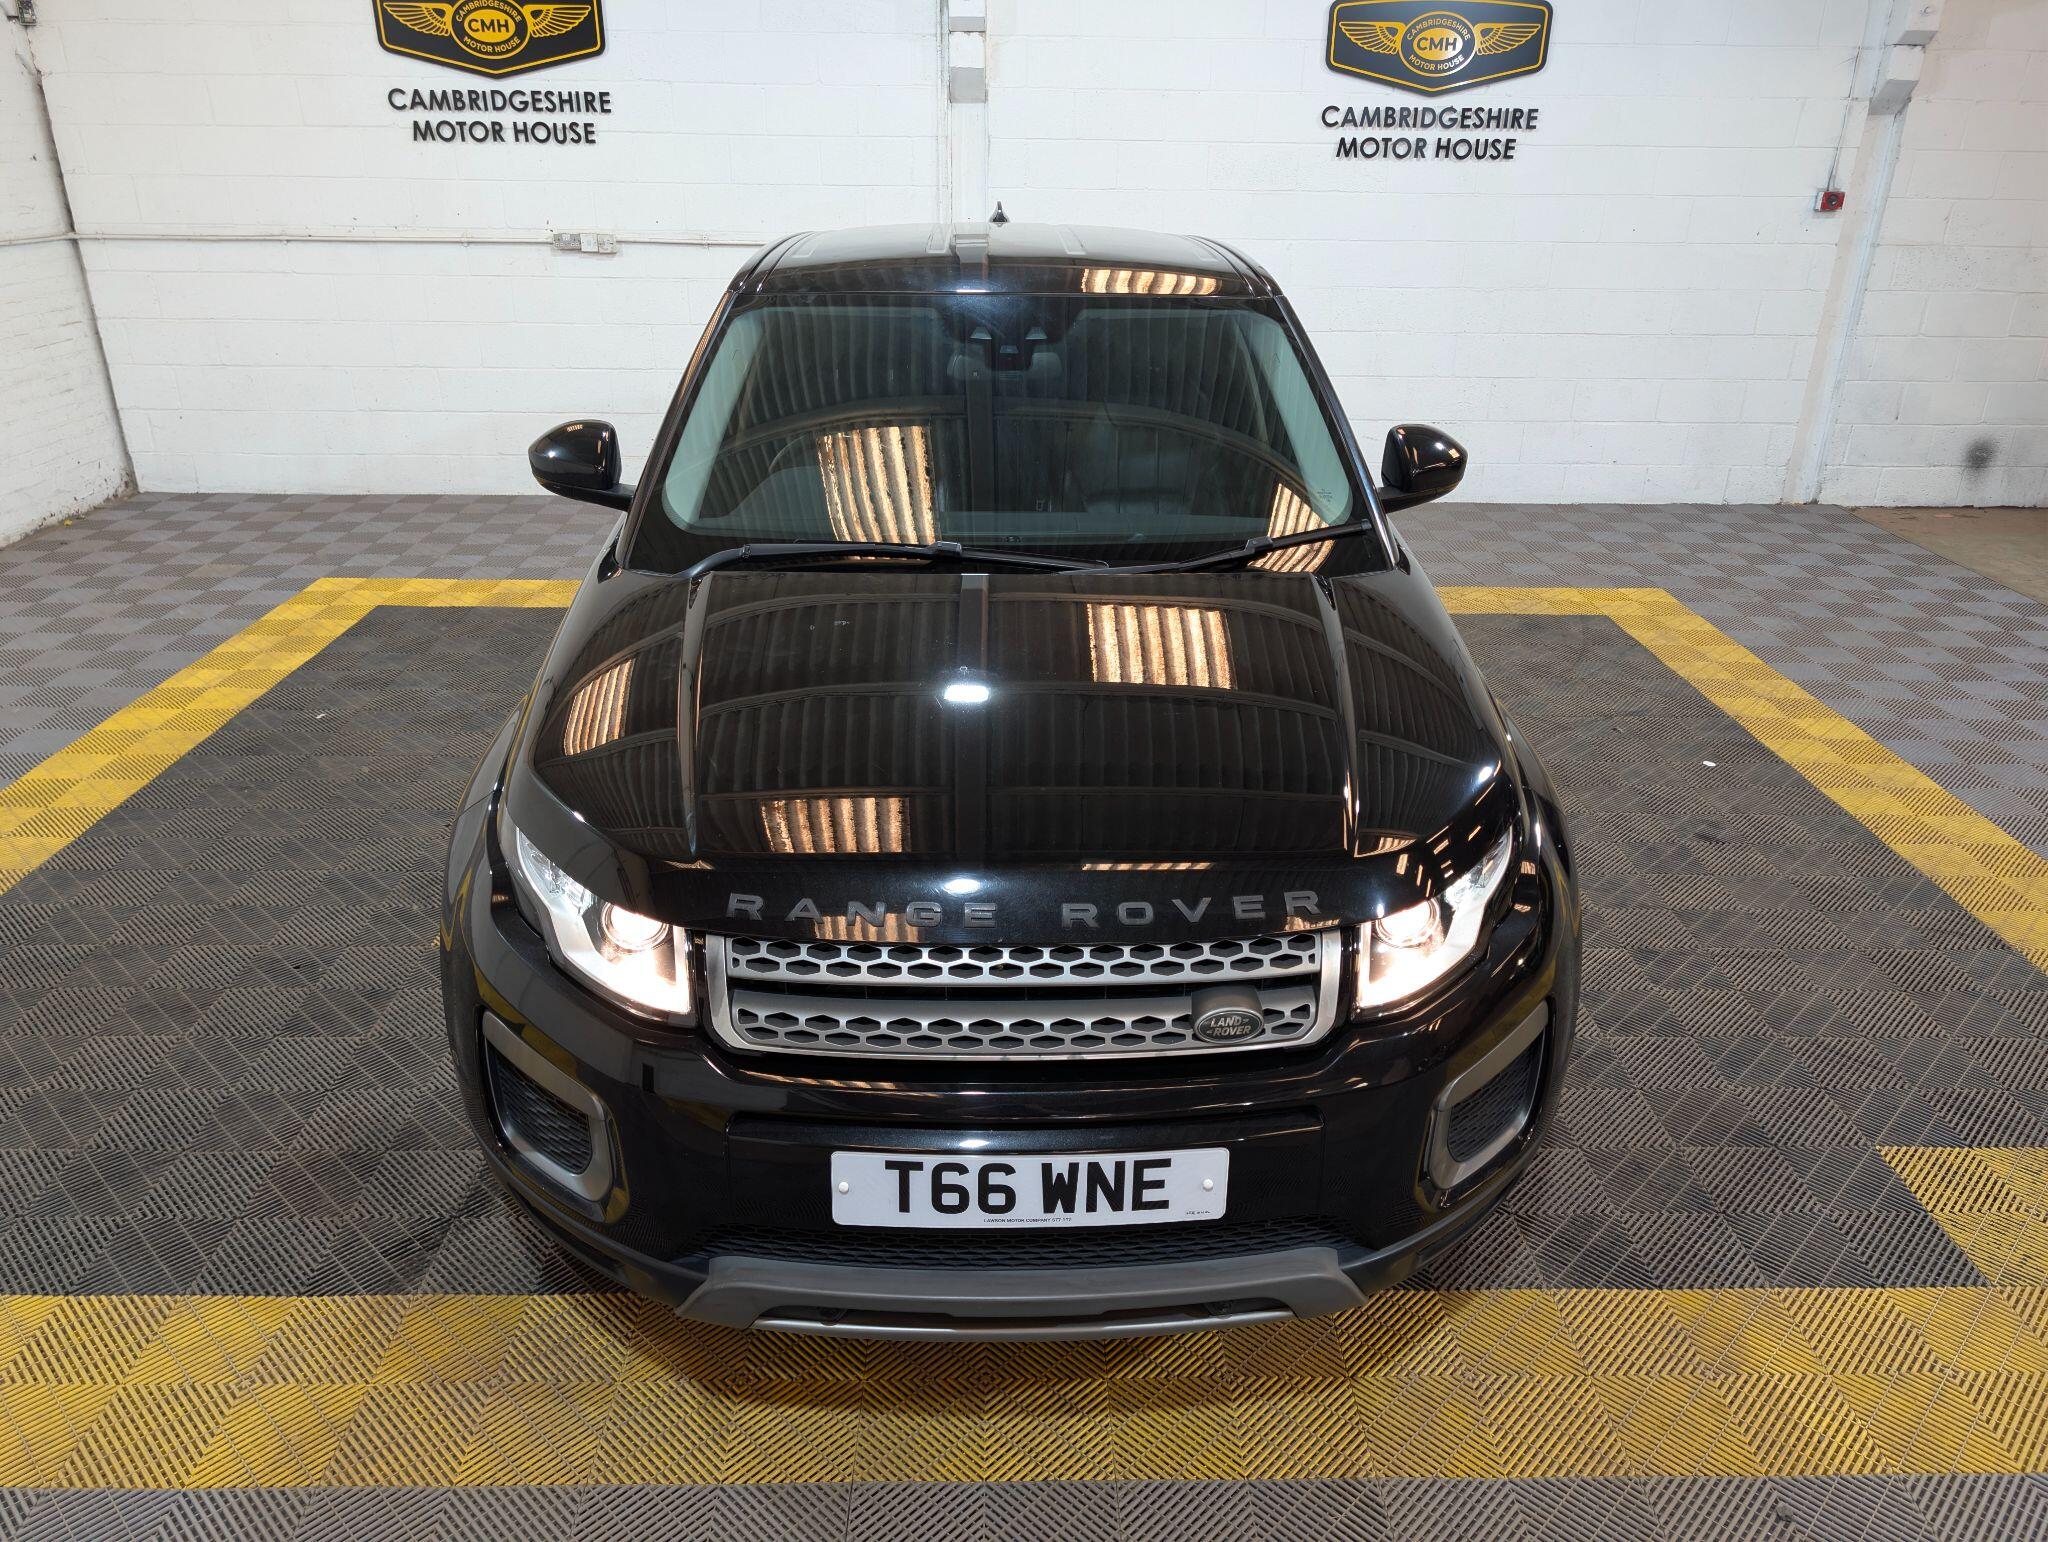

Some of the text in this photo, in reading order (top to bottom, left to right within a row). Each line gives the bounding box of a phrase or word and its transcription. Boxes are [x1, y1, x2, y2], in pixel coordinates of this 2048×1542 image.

[456, 0, 522, 22] CAMBRIDGESHIRE
[468, 19, 509, 33] CMH
[1406, 18, 1471, 40] CAMBRIDGESHIRE
[463, 36, 520, 53] MOTOR HOUSE
[1416, 37, 1457, 51] CMH
[1408, 54, 1465, 71] MOTOR HOUSE
[388, 88, 612, 114] CAMBRIDGESHIRE
[1321, 105, 1539, 130] CAMBRIDGESHIRE
[412, 120, 596, 144] MOTOR HOUSE
[1335, 136, 1517, 161] MOTOR HOUSE
[726, 889, 1322, 929] RANGE ROVER
[1210, 1015, 1242, 1028] LAND
[1213, 1025, 1252, 1037] ROVER
[884, 1157, 1172, 1215] T66 WNE
